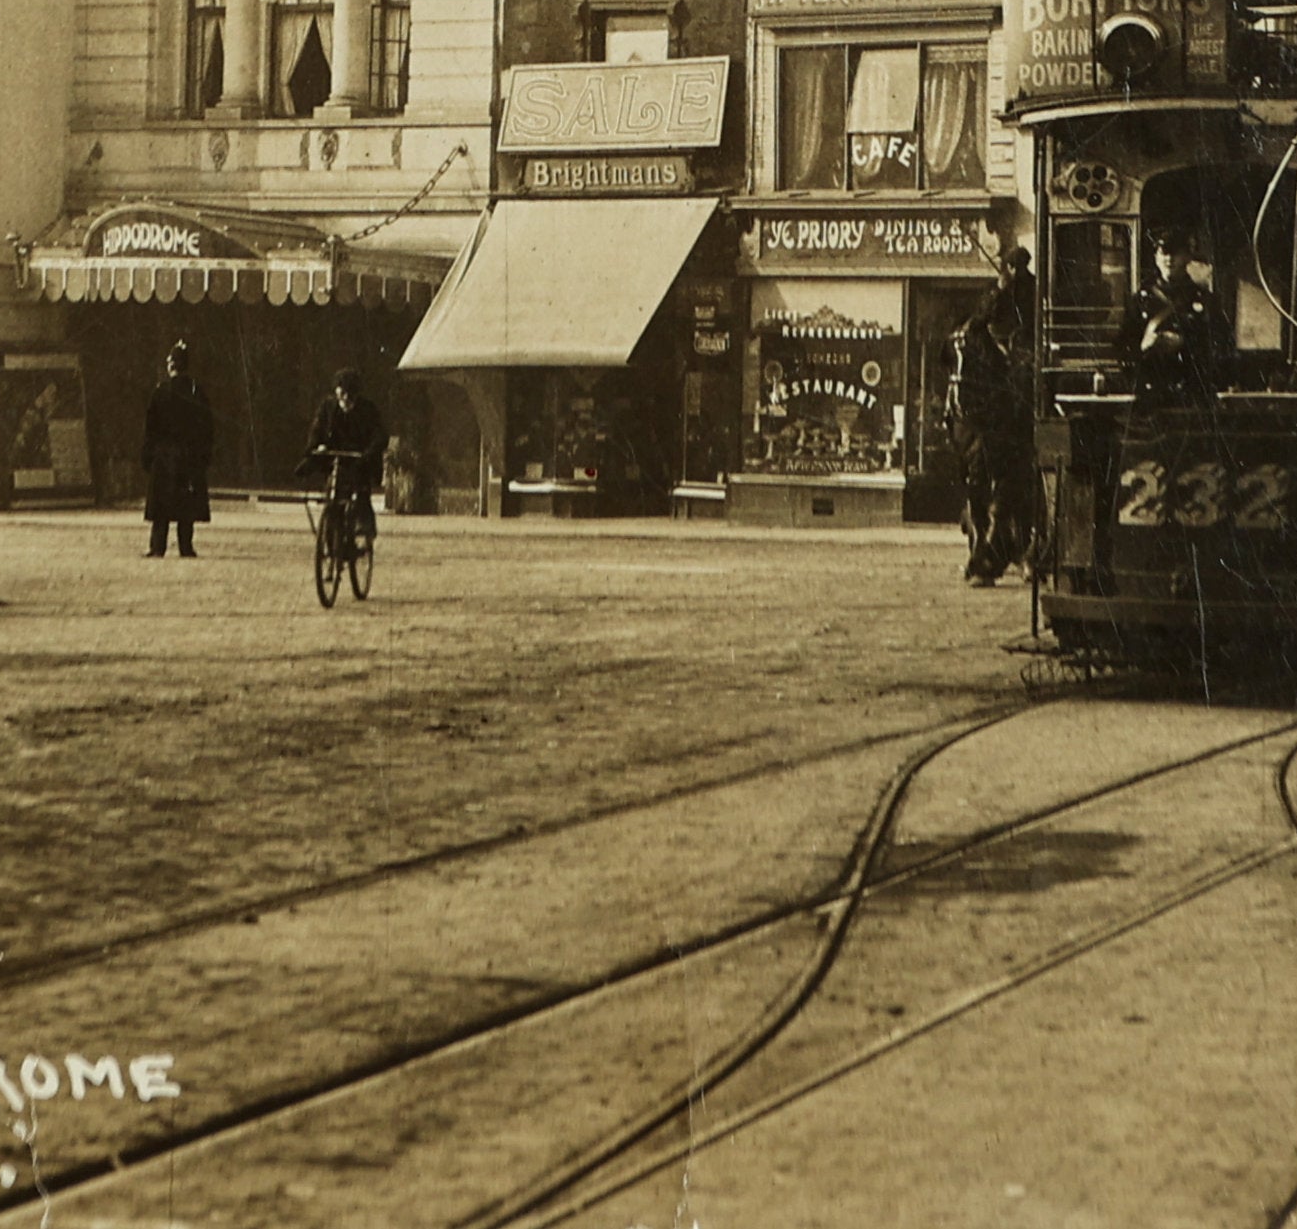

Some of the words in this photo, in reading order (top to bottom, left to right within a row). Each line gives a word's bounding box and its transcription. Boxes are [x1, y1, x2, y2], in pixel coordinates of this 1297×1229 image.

[1031, 29, 1102, 57] BAKIN
[512, 71, 717, 139] SALE
[852, 136, 918, 168] CAFE
[533, 159, 678, 190] Brightmans
[104, 220, 201, 257] HIPPODROME
[796, 219, 866, 250] PRIORY
[873, 218, 942, 237] DINING
[884, 236, 919, 254] TEA
[922, 234, 973, 254] ROOMS
[781, 324, 883, 340] REFRESHMENTS
[769, 378, 878, 410] RESTAURANT
[1117, 459, 1289, 529] 232
